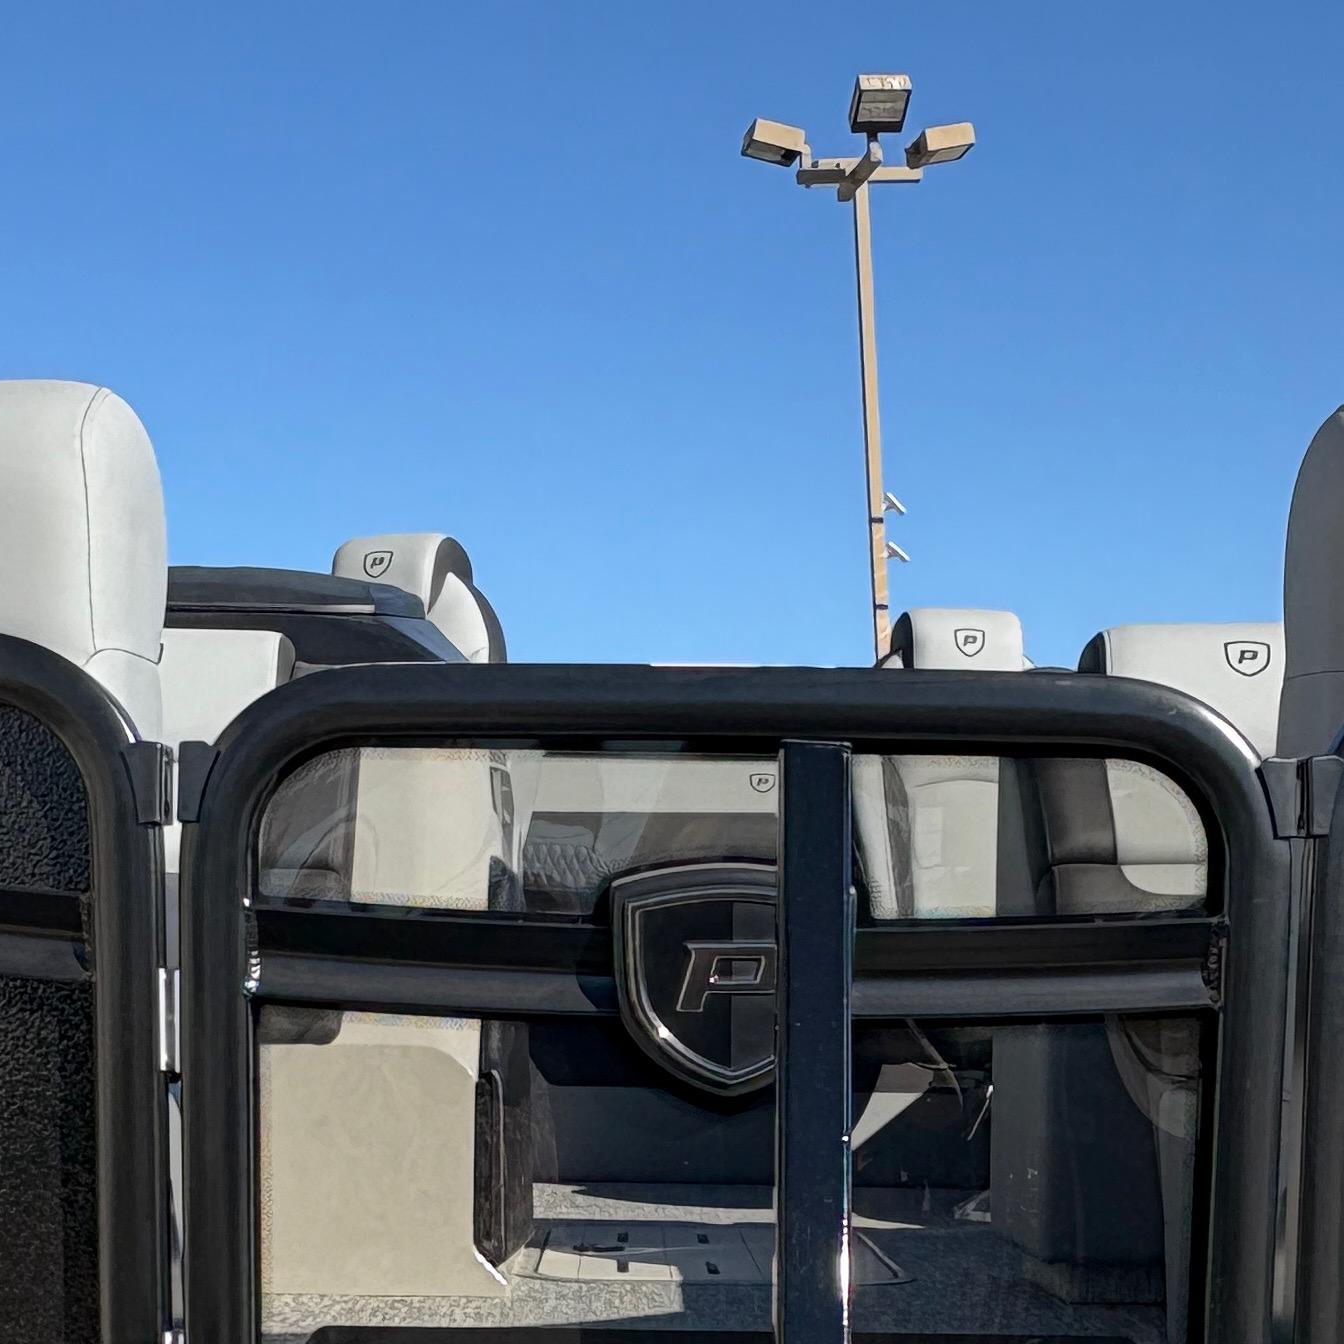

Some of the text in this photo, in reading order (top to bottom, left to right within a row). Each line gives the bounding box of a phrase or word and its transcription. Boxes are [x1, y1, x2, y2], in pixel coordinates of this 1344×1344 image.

[963, 635, 977, 646] P
[1238, 649, 1258, 664] P
[676, 940, 778, 1012] P
